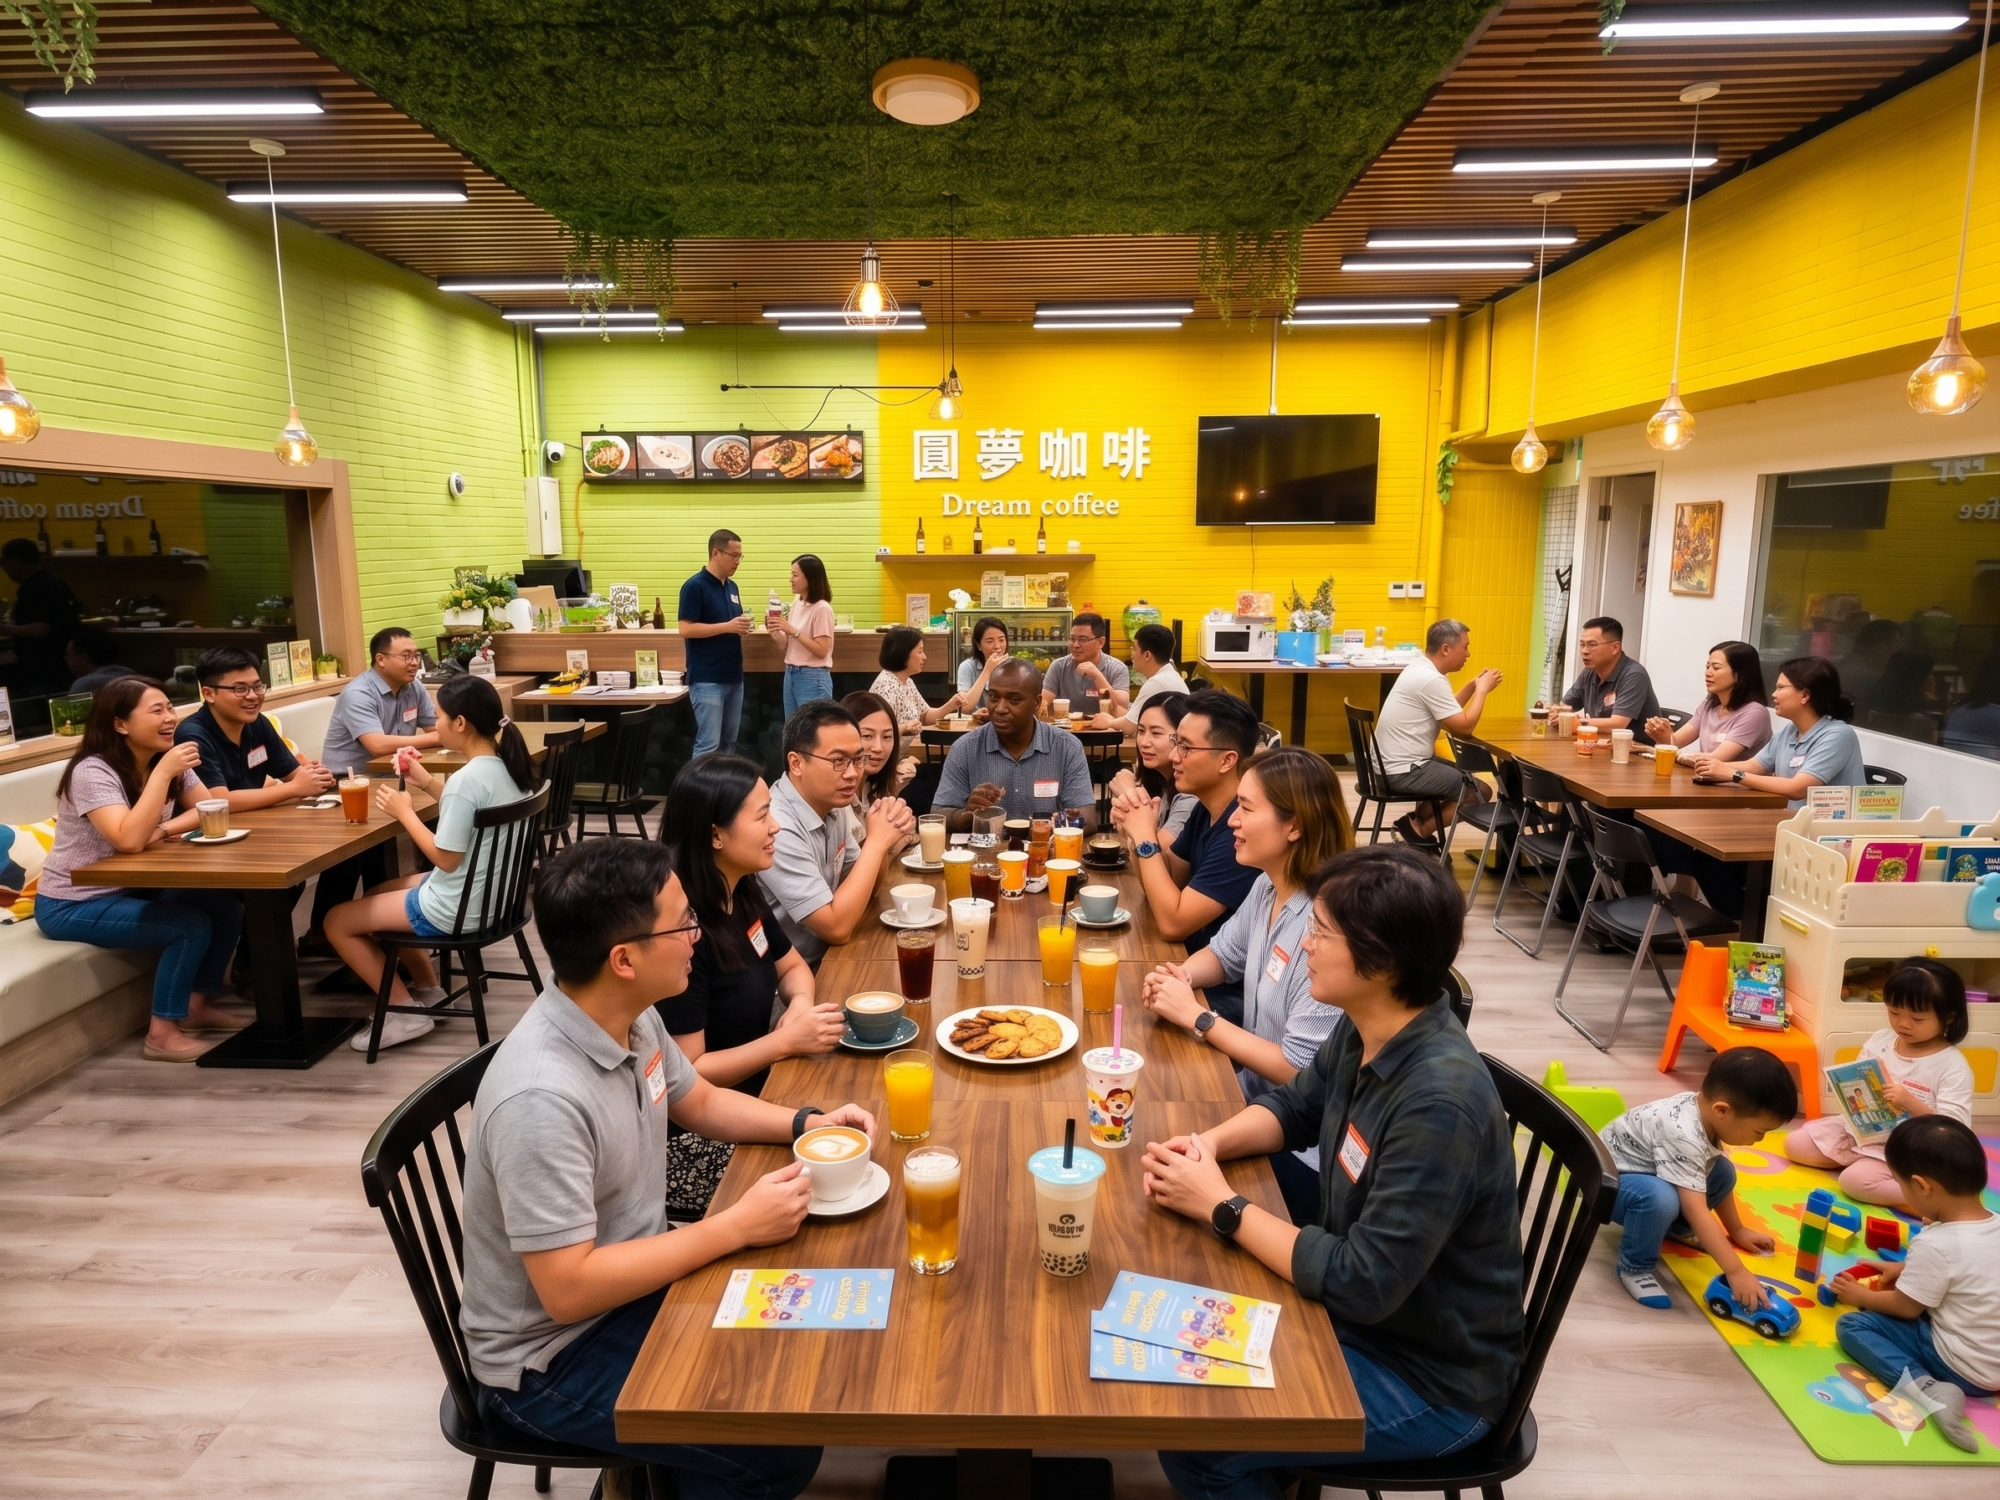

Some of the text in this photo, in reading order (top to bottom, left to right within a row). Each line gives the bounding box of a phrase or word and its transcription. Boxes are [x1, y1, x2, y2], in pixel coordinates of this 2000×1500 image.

[913, 427, 1151, 481] 圓夢咖啡
[942, 492, 1120, 516] Dream coffee
